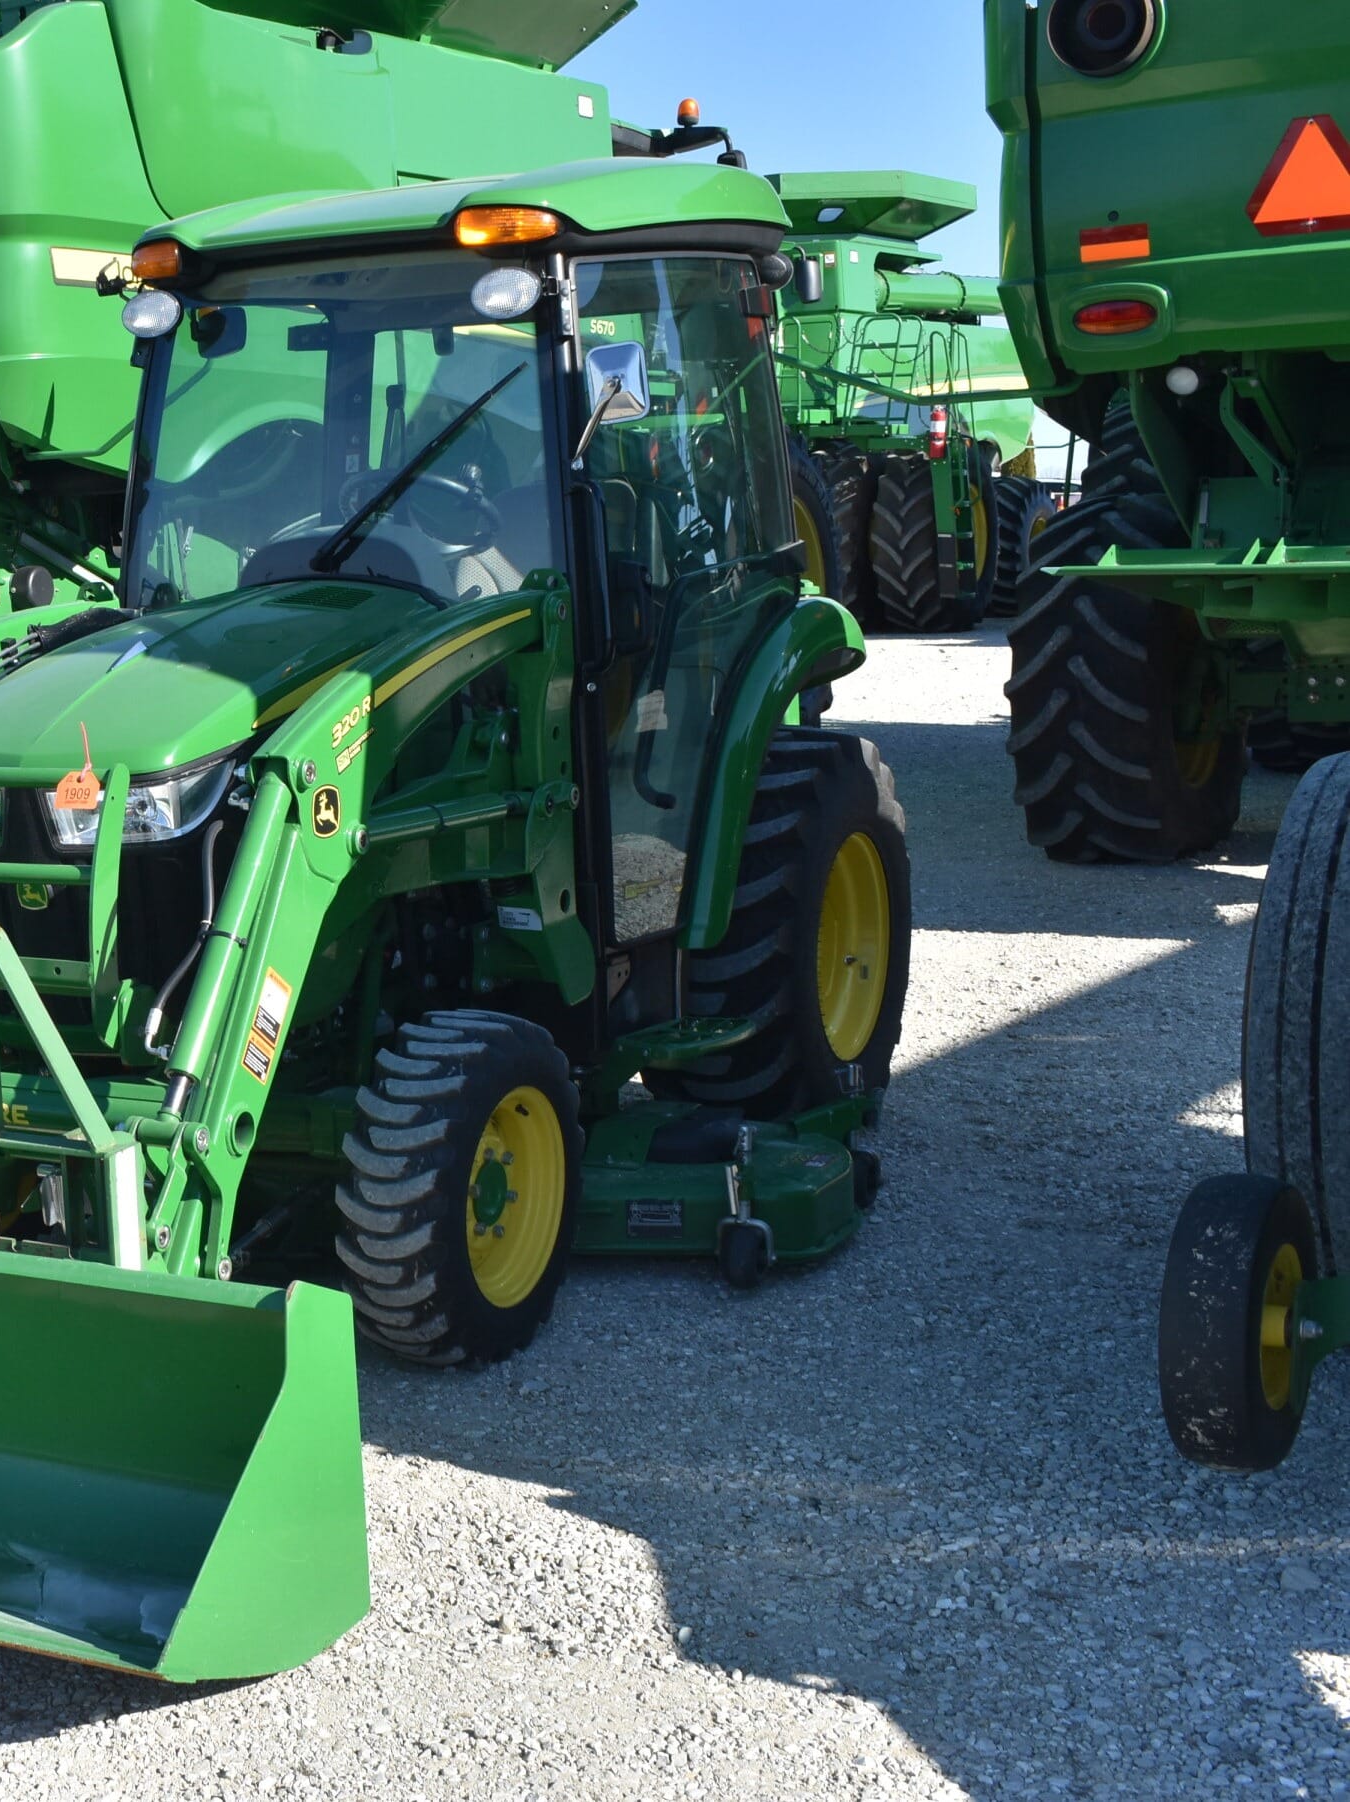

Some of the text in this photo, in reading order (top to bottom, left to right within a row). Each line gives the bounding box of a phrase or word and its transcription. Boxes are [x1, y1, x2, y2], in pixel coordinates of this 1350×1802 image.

[590, 319, 615, 336] S670
[332, 694, 371, 750] 320 R
[63, 787, 91, 801] 1909
